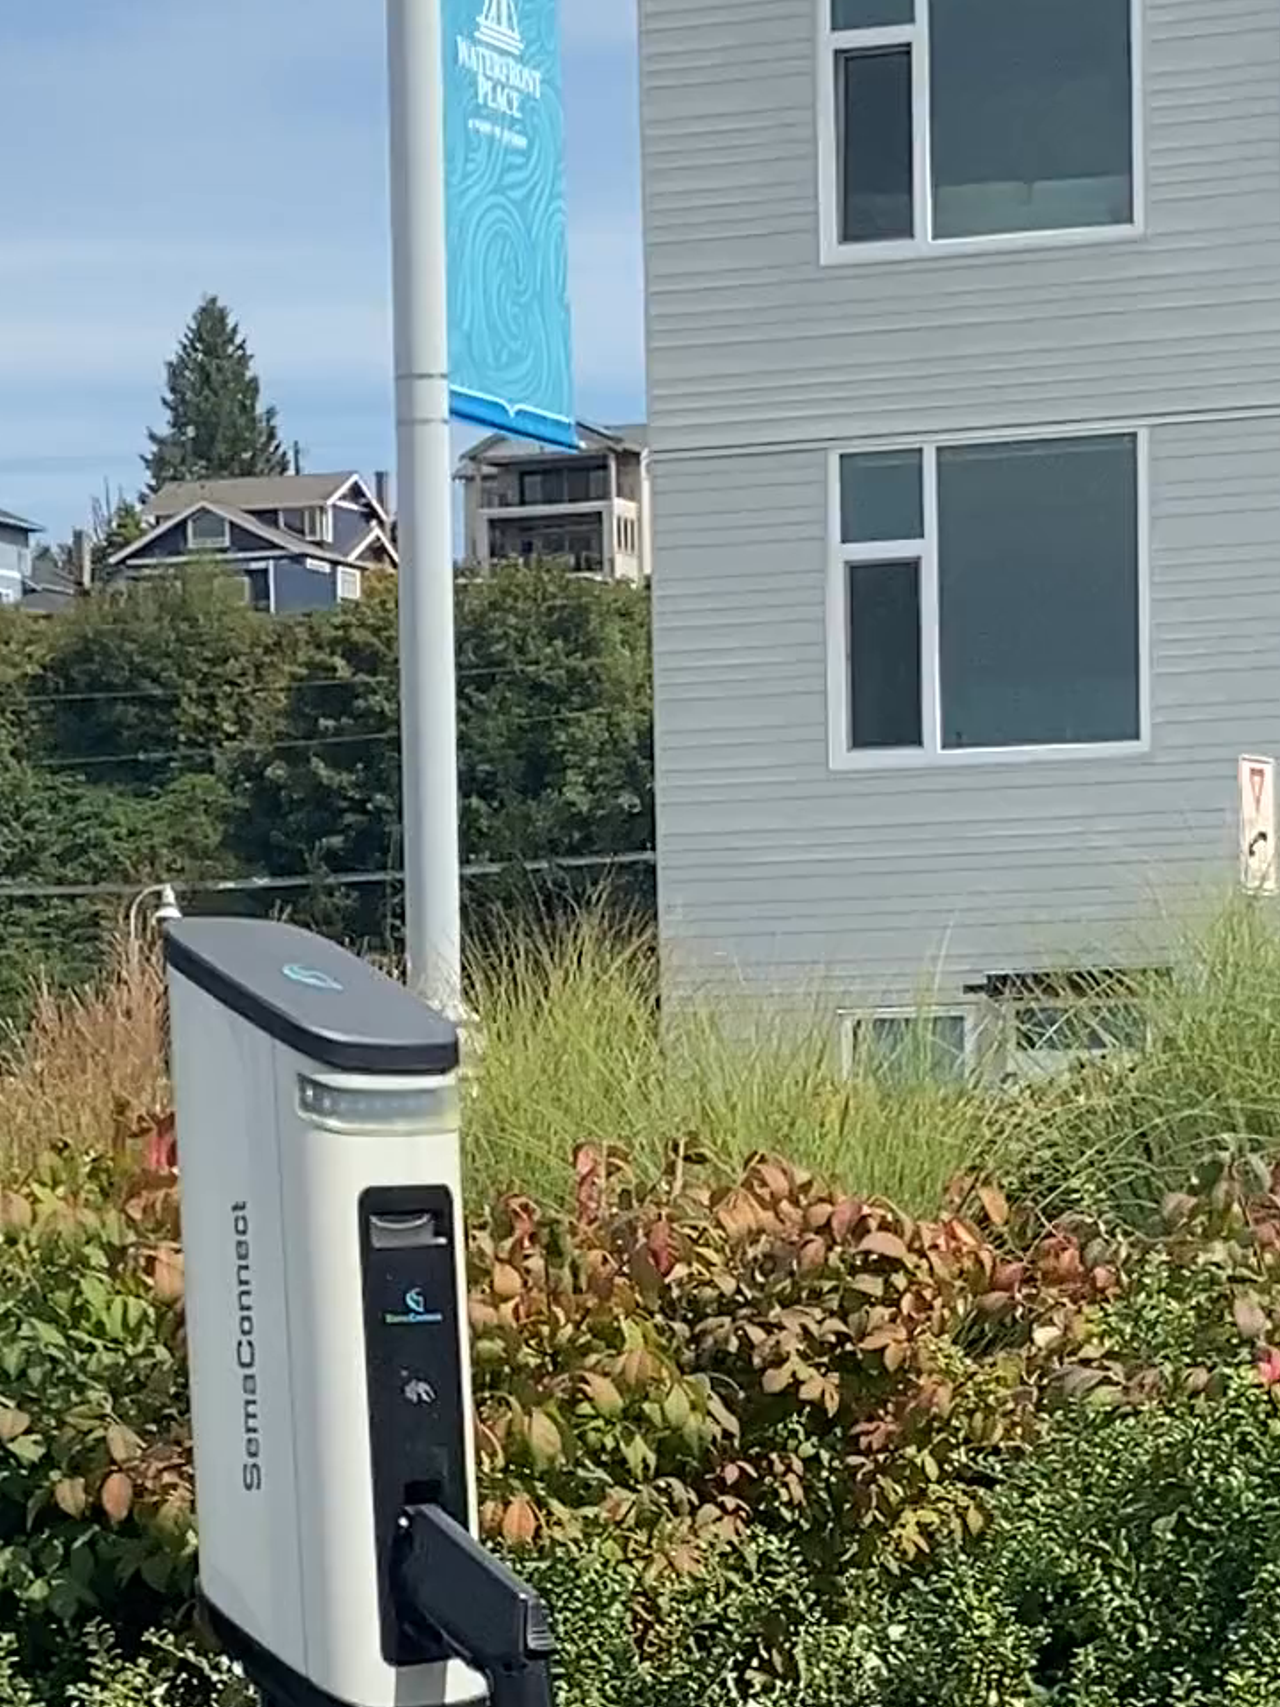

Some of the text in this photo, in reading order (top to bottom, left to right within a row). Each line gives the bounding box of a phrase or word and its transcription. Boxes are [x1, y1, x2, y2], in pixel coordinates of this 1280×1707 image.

[455, 34, 541, 100] WATERFRONT
[477, 74, 523, 118] PLACE
[230, 1200, 262, 1492] SemaConnect
